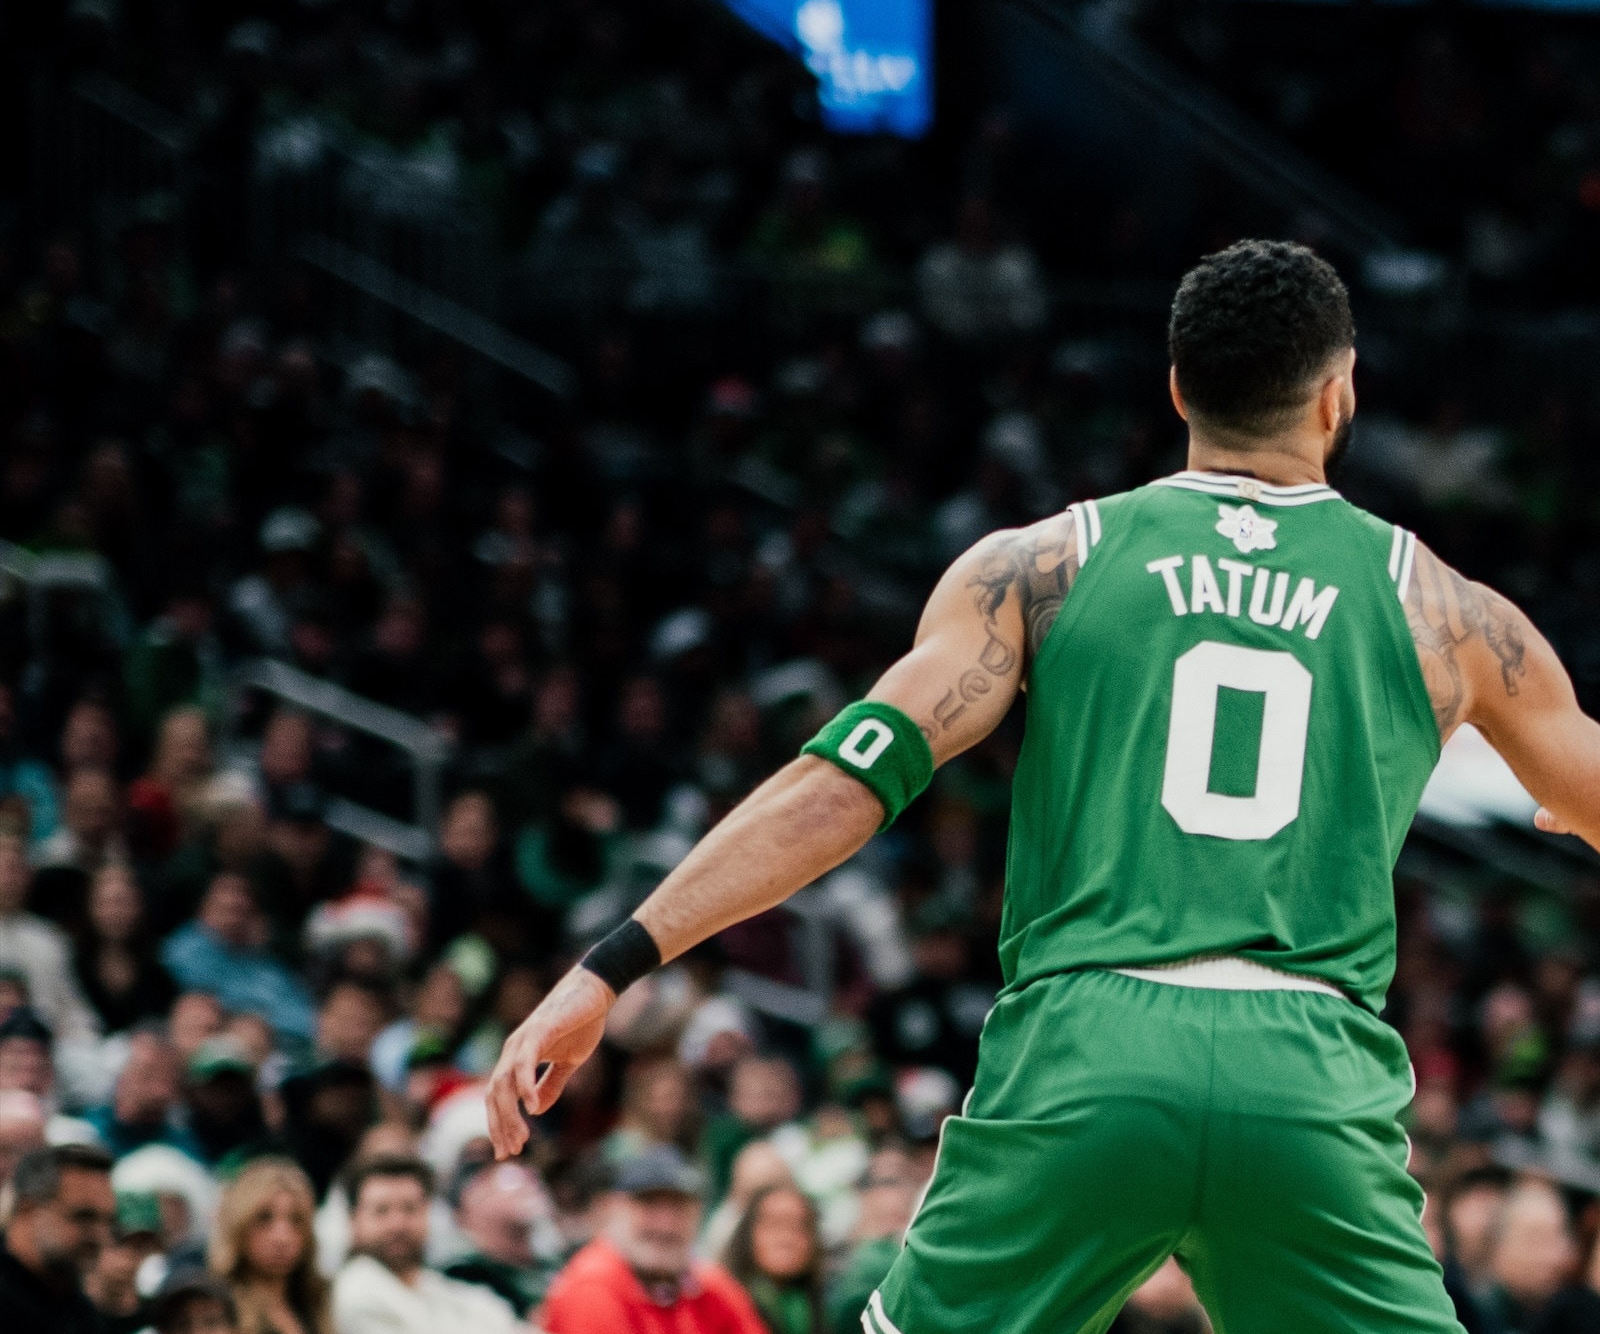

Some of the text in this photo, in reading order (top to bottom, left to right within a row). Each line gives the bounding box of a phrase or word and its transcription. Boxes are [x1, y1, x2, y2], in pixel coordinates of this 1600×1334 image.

[1146, 555, 1340, 641] TATUM
[838, 718, 895, 770] 0
[1160, 640, 1314, 841] 0
